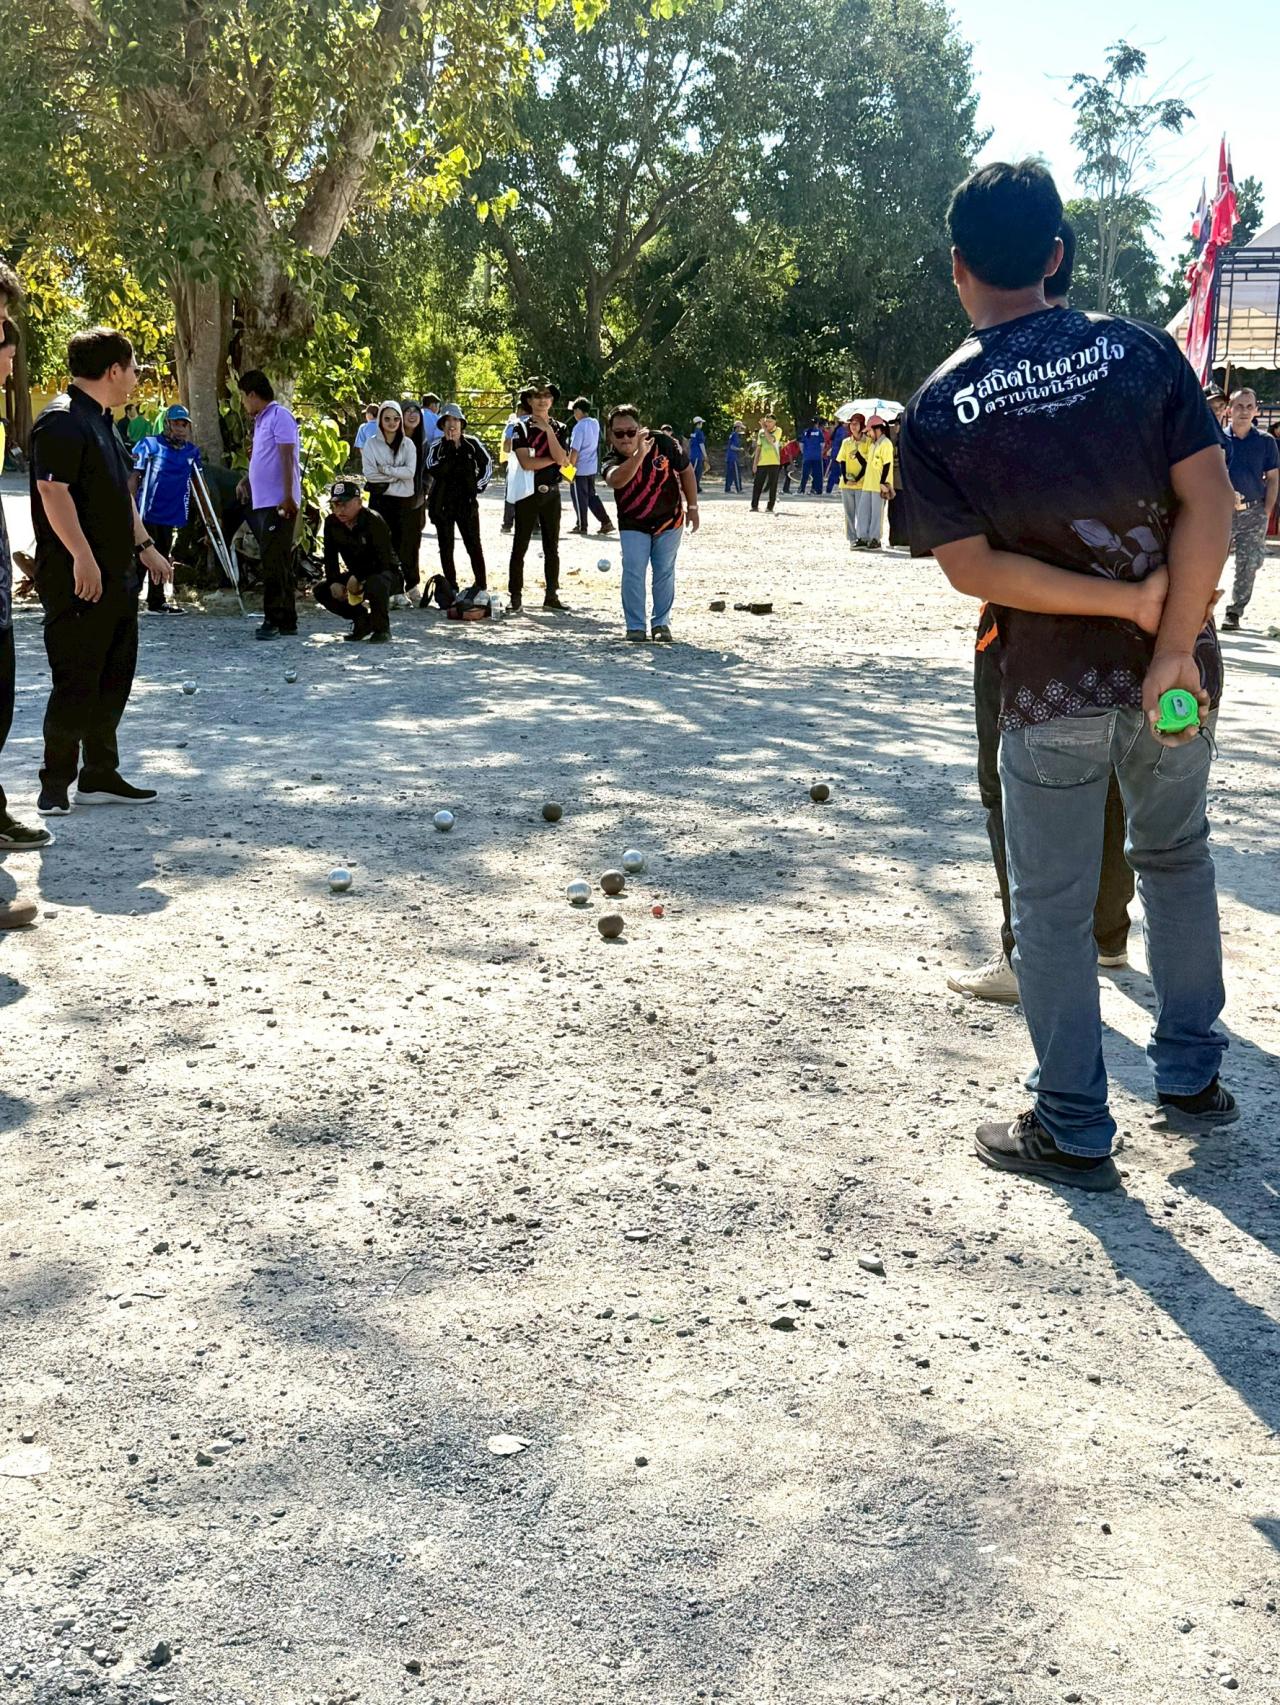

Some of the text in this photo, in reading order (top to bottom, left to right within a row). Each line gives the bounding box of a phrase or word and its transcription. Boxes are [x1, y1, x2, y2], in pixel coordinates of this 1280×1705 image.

[976, 336, 1125, 399] สถิตในดวงใจ
[984, 362, 1109, 414] ตราบนิจนิรันดร์
